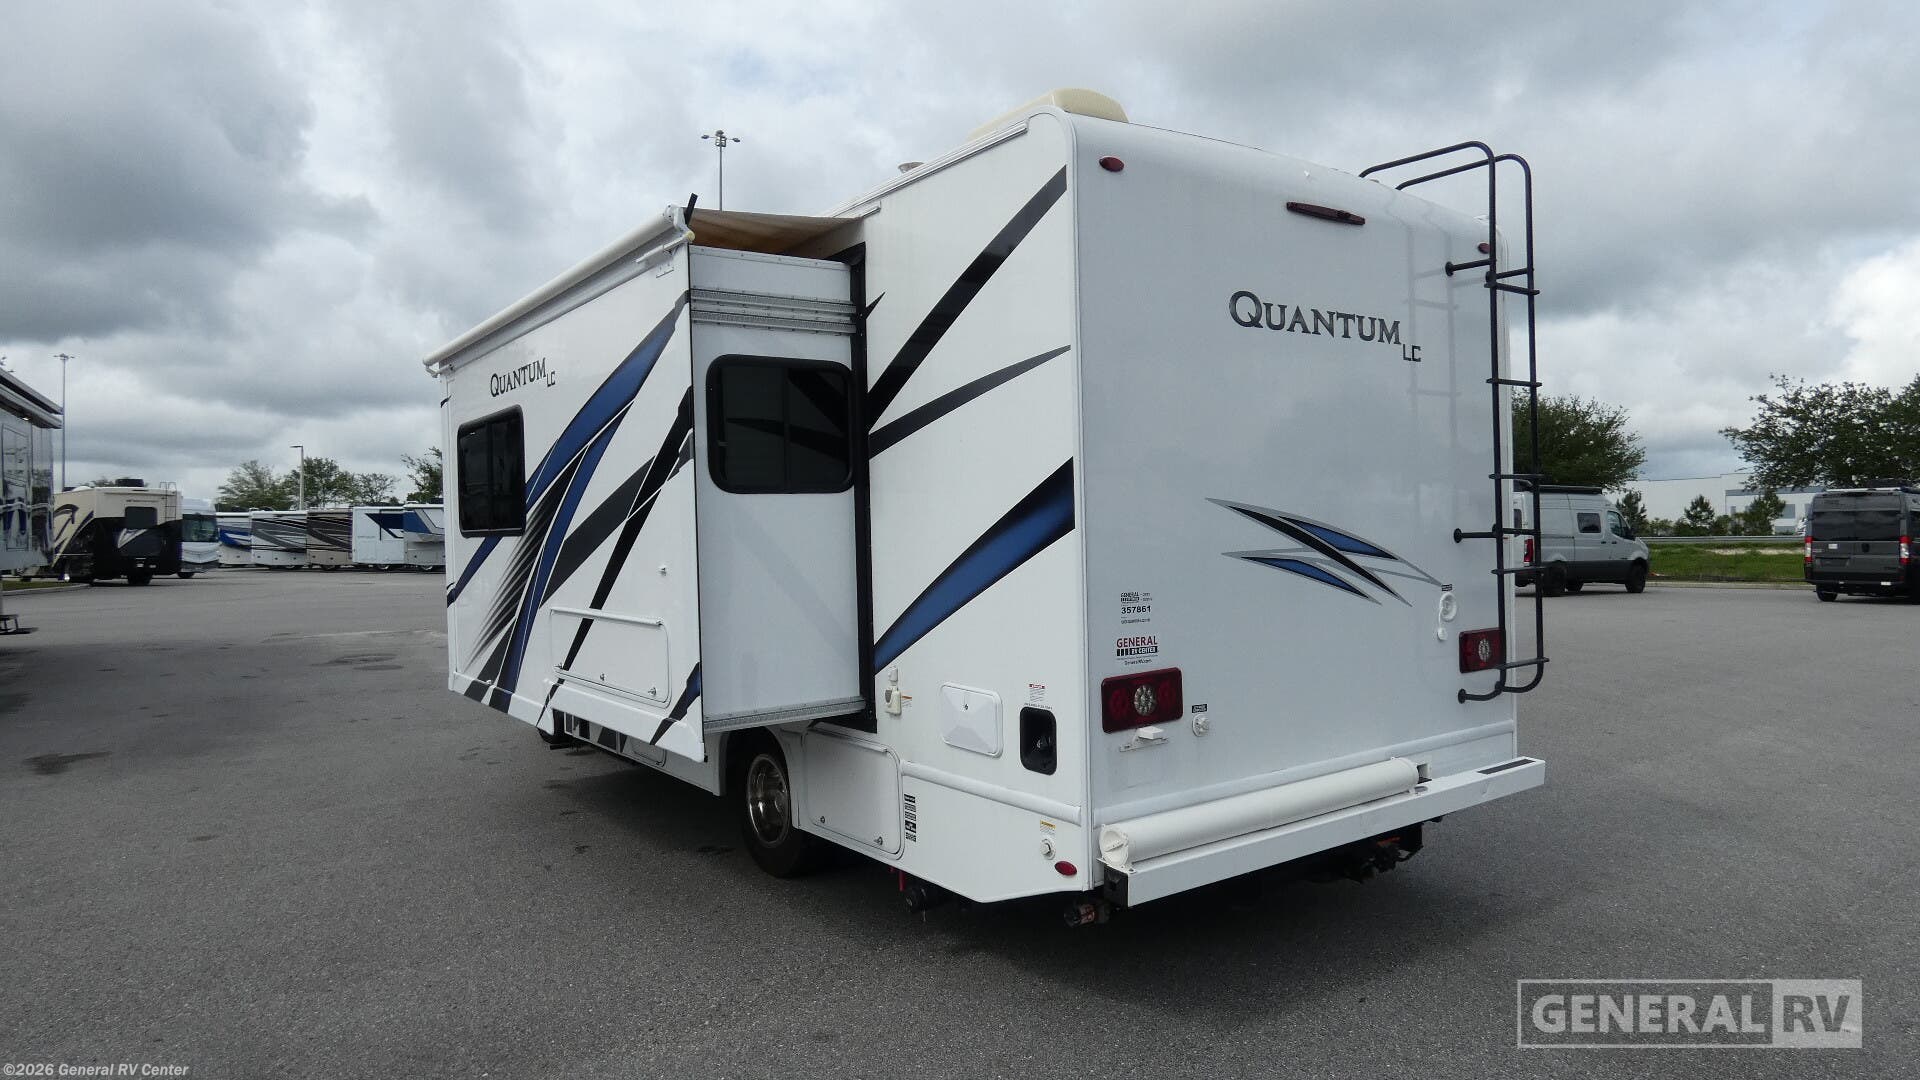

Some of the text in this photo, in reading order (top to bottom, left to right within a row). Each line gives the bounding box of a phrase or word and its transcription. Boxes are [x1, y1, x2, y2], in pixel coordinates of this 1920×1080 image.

[1229, 290, 1422, 362] QUANTUM LC
[546, 371, 556, 388] LC
[1121, 605, 1151, 615] 357861
[1116, 635, 1158, 648] GENERAL
